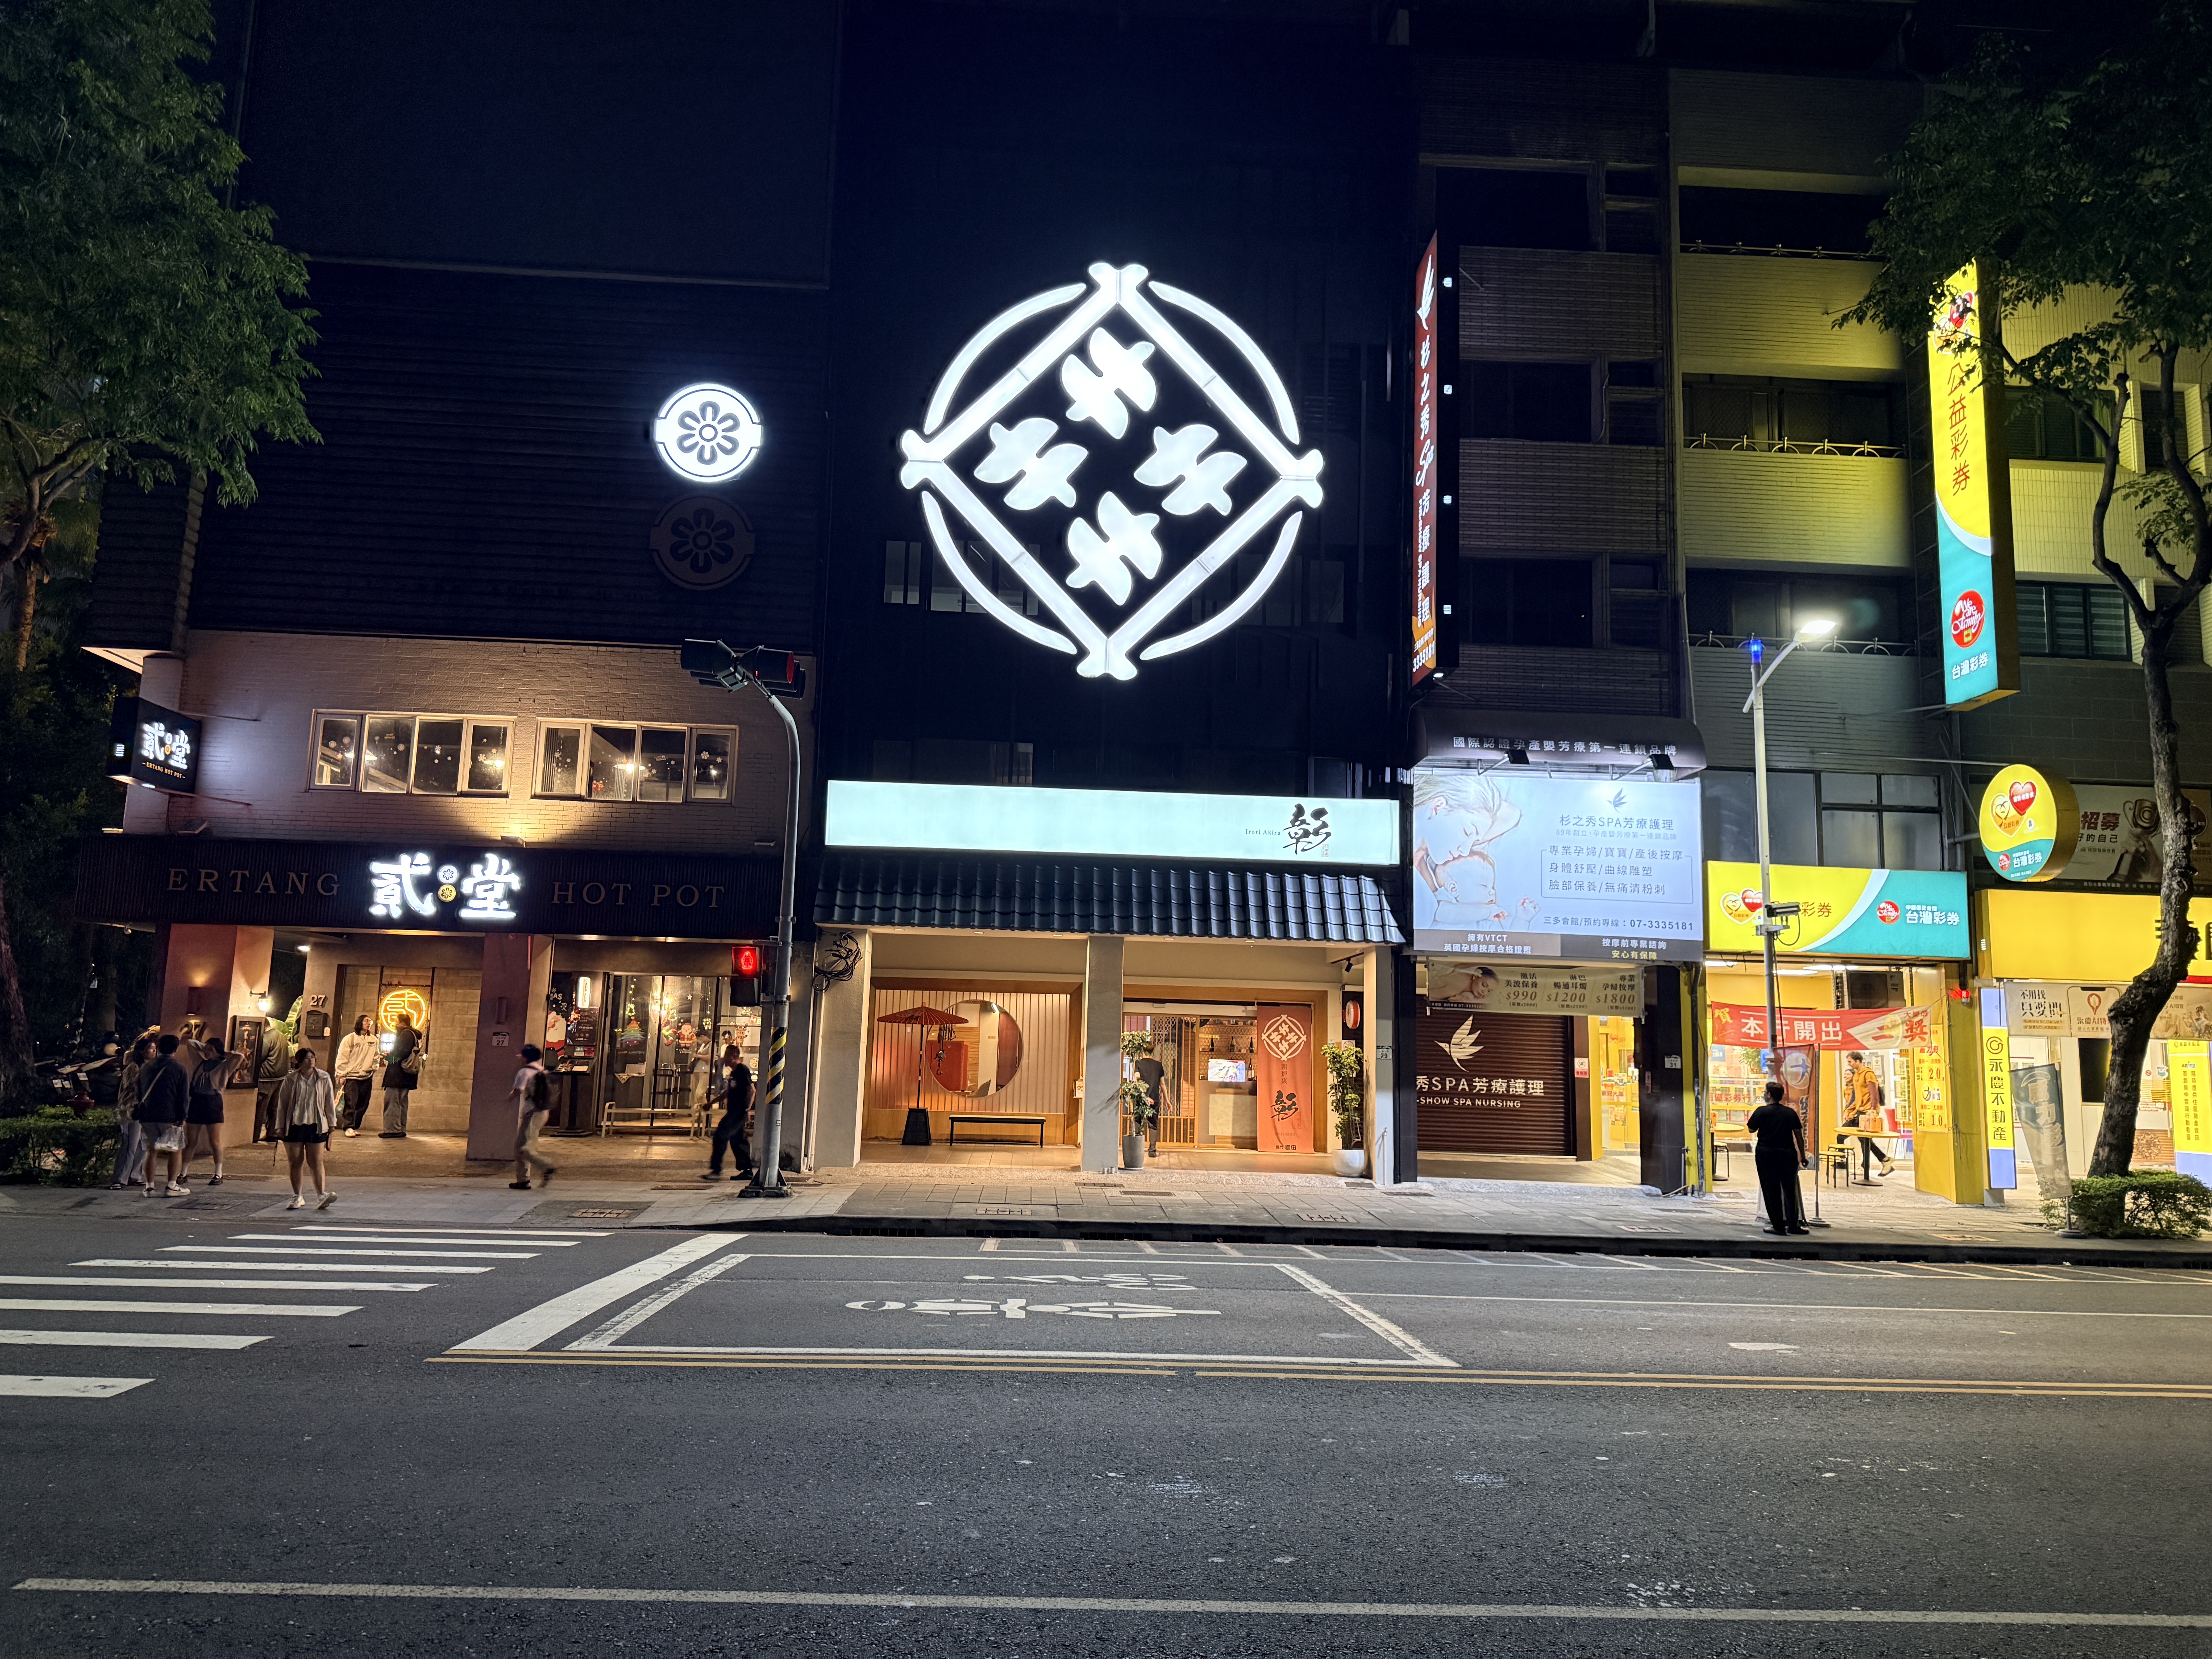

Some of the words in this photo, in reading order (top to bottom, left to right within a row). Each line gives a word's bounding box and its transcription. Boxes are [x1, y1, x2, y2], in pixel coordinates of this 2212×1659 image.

[1947, 362, 1970, 496] 公益彩券
[1951, 652, 1988, 680] 台灣彩券
[1453, 736, 1677, 756] 國際認證孕產嬰芳療第一連鎖品牌
[146, 762, 163, 772] ERTANG
[1559, 814, 1674, 831] 杉之秀SPA芳療護理
[2081, 811, 2120, 831] 招募
[1549, 845, 1683, 861] 專業孕婦/寶寶/產後按摩
[2013, 852, 2042, 868] 台灣彩券
[1549, 862, 1652, 876] 身體舒壓/曲線雕塑
[167, 868, 340, 896] ERTANG
[1549, 879, 1666, 895] 臉部保養/無痛清粉刺
[551, 881, 632, 905] HOT
[651, 884, 725, 908] POT
[1906, 910, 1960, 925] 台灣彩券
[1611, 950, 1657, 960] 安心有保障
[1620, 974, 1635, 982] 專業
[309, 994, 326, 1006] 27
[1506, 990, 1537, 1001] $990
[1546, 992, 1586, 1002] $1200
[1595, 993, 1635, 1004] $1800
[1714, 1008, 1733, 1024] 賀
[2077, 1017, 2110, 1025] 永慶AI特
[1453, 1097, 1472, 1106] SPA
[1475, 1099, 1521, 1108] NURSING
[1989, 1058, 2007, 1141] 永慶不動產
